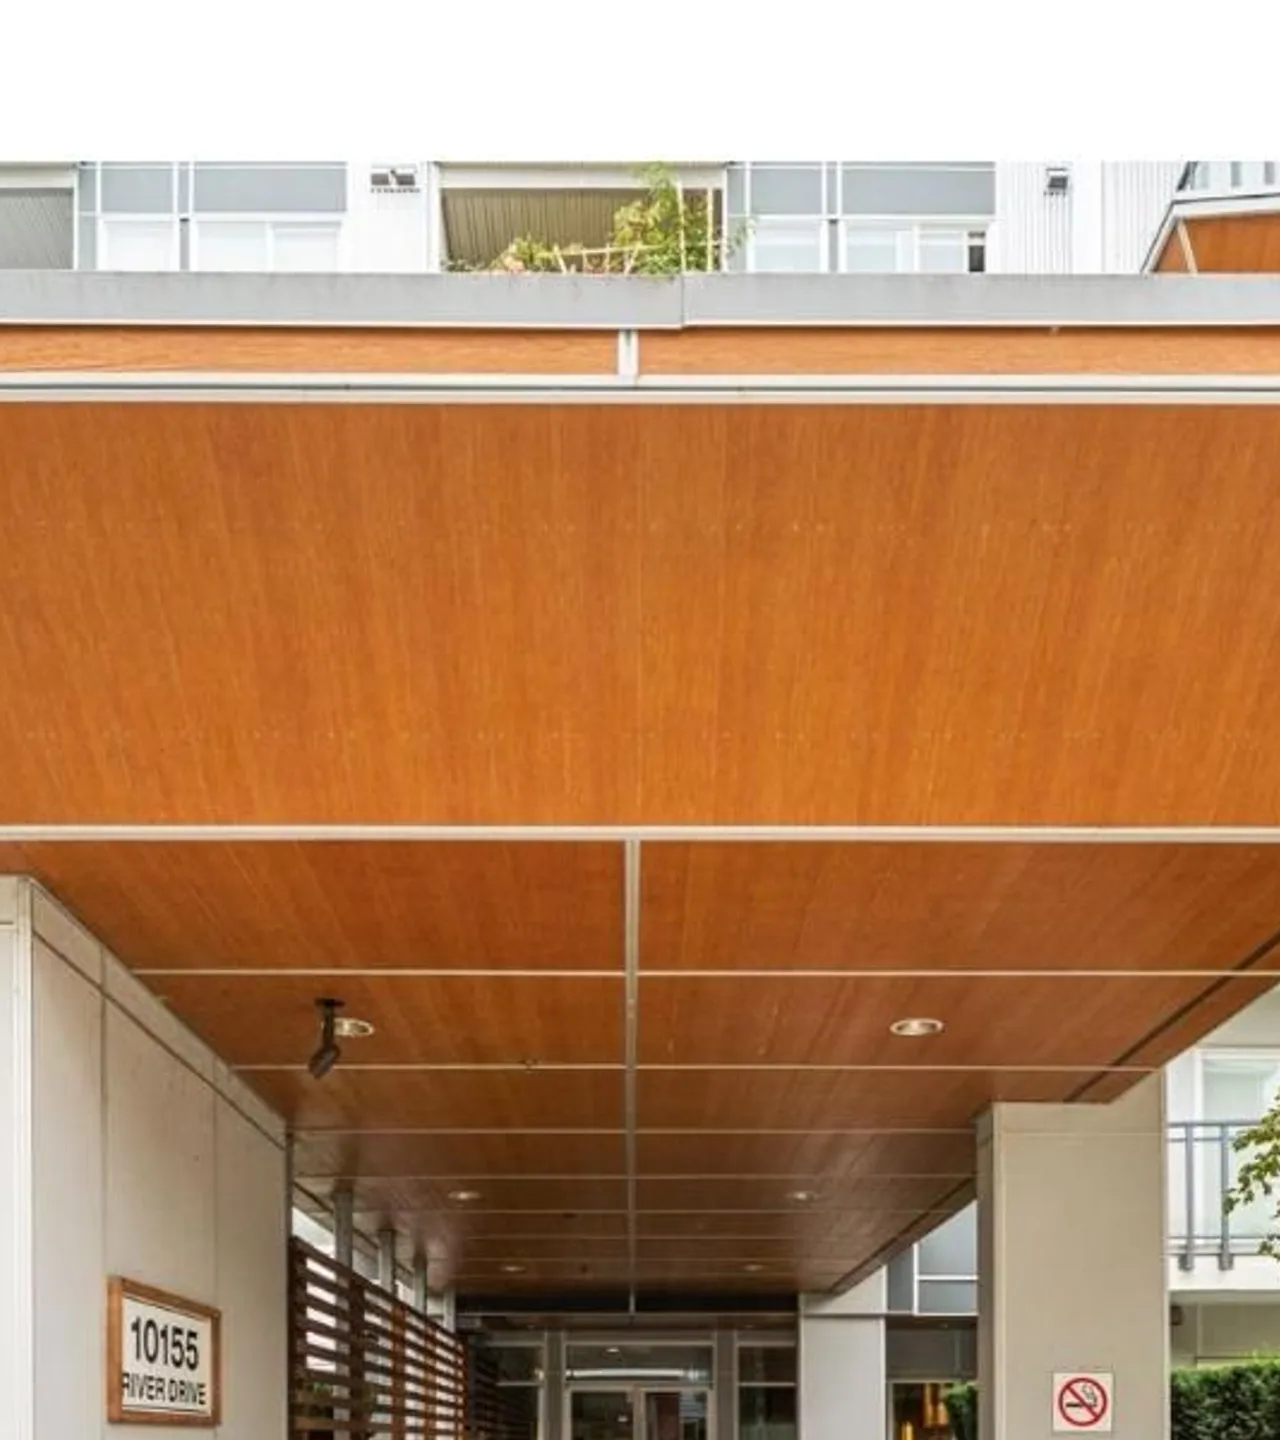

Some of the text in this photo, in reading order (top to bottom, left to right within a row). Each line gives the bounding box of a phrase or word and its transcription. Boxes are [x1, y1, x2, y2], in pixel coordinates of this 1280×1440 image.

[131, 1315, 199, 1371] 10155
[121, 1372, 206, 1405] RIVER DRIVE
